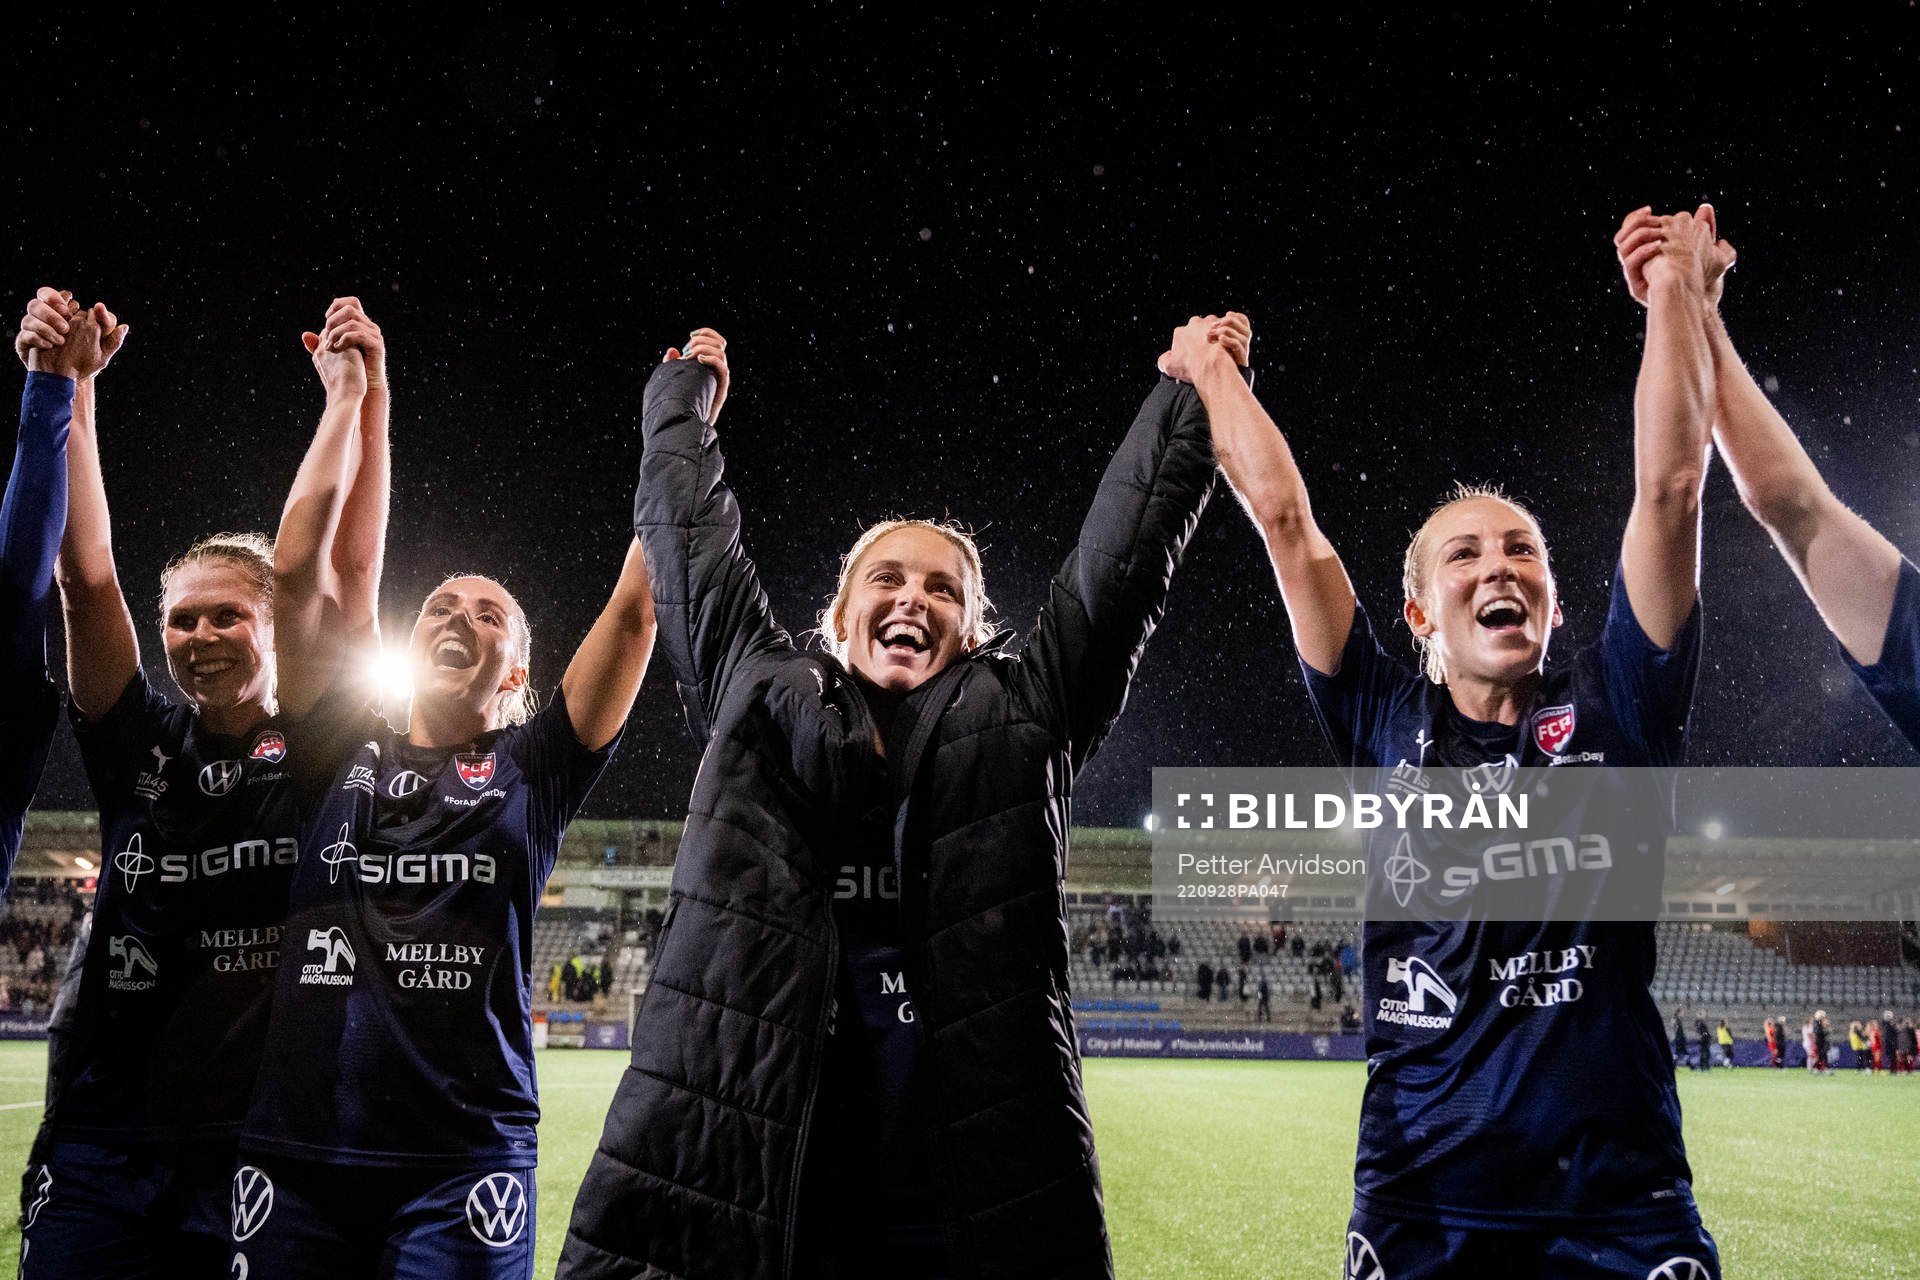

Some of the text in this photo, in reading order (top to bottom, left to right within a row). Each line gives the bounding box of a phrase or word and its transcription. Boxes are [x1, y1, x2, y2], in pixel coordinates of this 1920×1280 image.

[1538, 715, 1571, 741] FCR
[461, 761, 491, 773] FCR
[201, 926, 286, 948] MELLB
[385, 943, 485, 965] MELLBY
[1489, 945, 1597, 981] MELLBY
[300, 974, 353, 986] MAGNUSSON
[302, 964, 323, 975] OTTO
[399, 964, 472, 990] GÅRD
[1500, 977, 1584, 1009] GÅRD
[1380, 998, 1409, 1013] OTTO
[1376, 1009, 1453, 1029] MAGNUSSON
